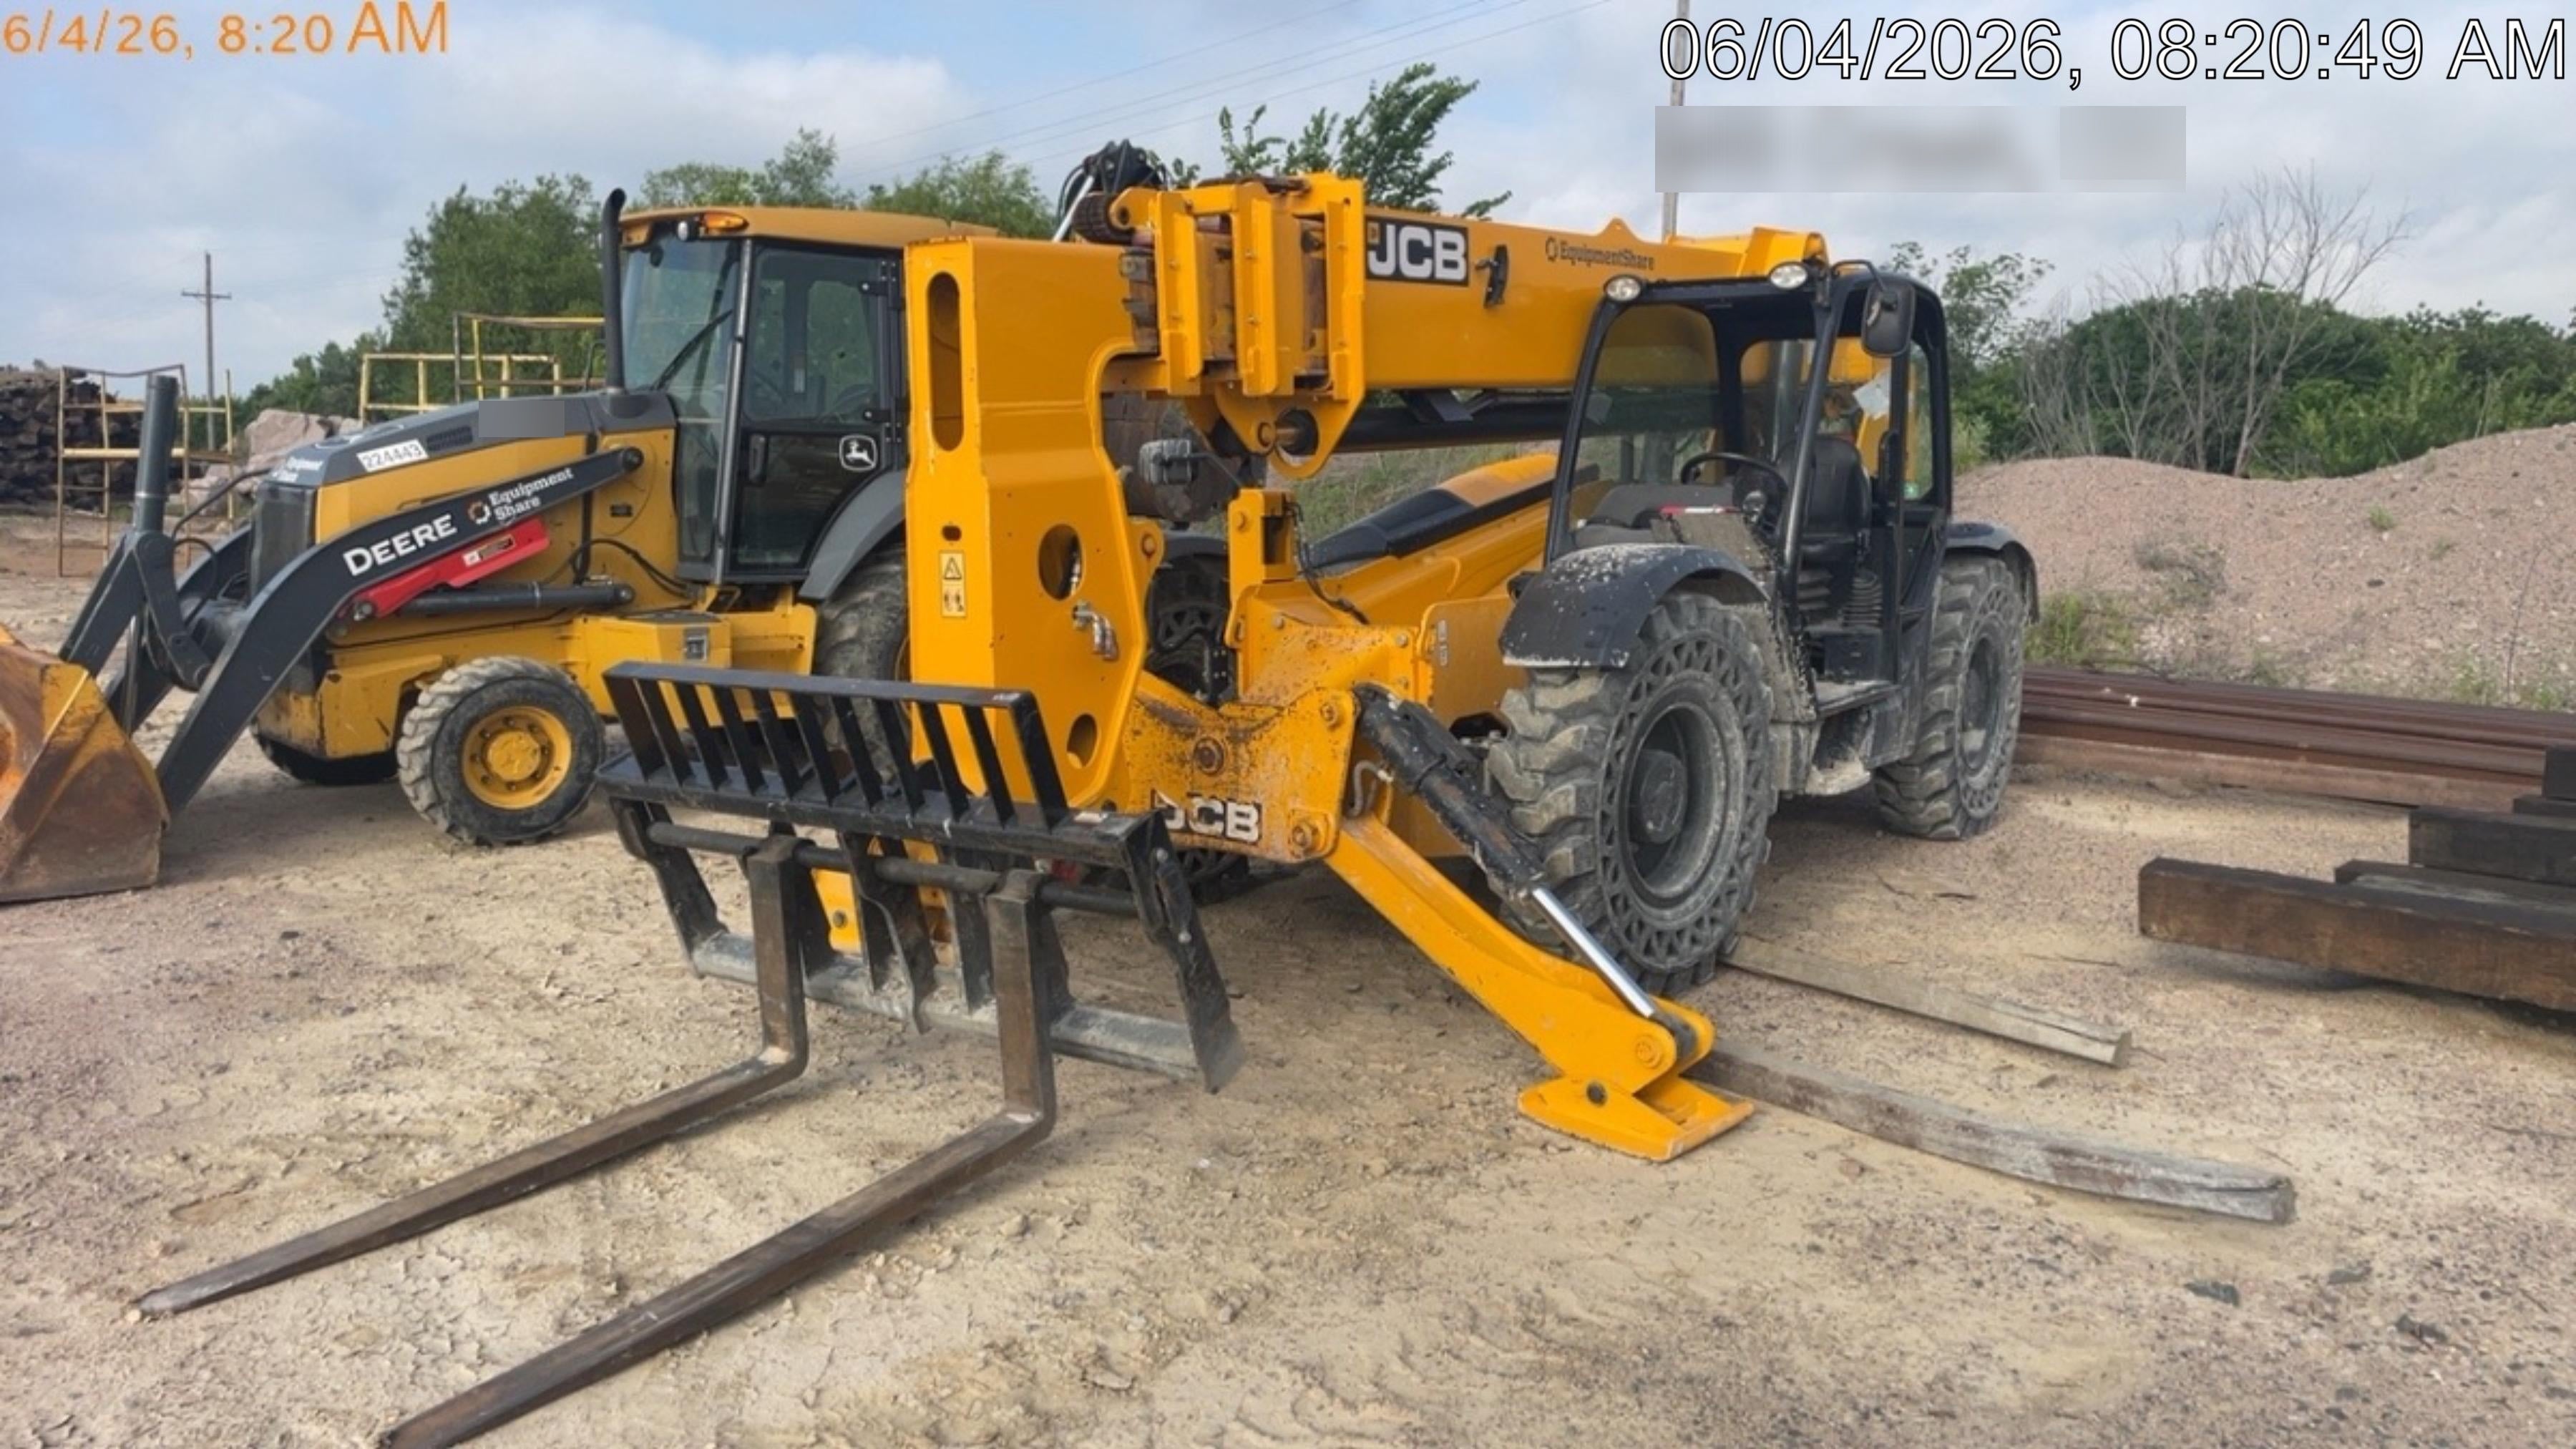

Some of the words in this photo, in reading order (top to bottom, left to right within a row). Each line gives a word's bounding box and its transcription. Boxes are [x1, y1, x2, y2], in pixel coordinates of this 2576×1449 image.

[1367, 223, 1467, 281] JCB
[1560, 240, 1654, 270] EquipmentShare
[488, 467, 574, 506] Equipment
[493, 495, 541, 522] Share
[343, 514, 458, 576] DEERE
